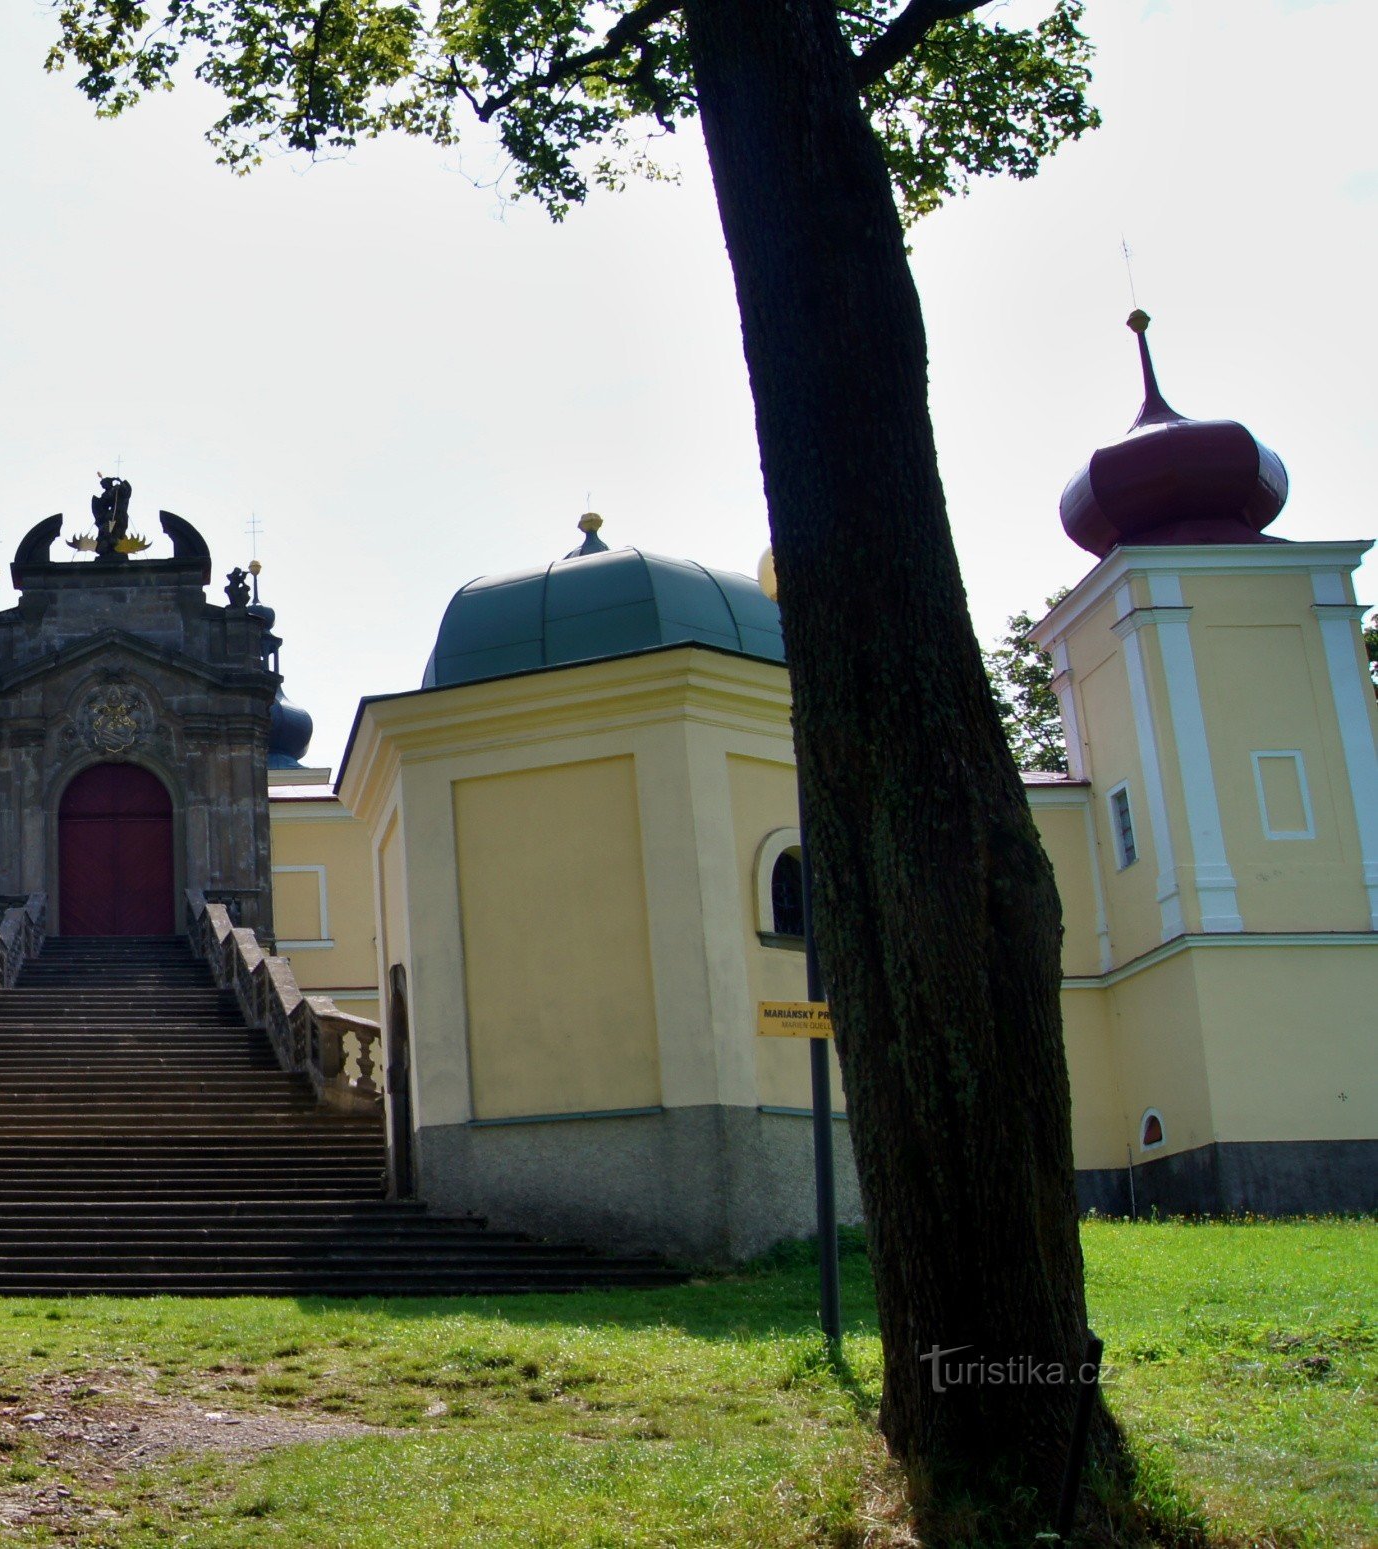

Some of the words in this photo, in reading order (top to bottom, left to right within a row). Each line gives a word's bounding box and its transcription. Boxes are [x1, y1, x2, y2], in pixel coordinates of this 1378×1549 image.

[764, 1007, 814, 1019] MARIÁNSKÝ
[817, 1010, 830, 1020] PR
[809, 1021, 831, 1030] QUELL
